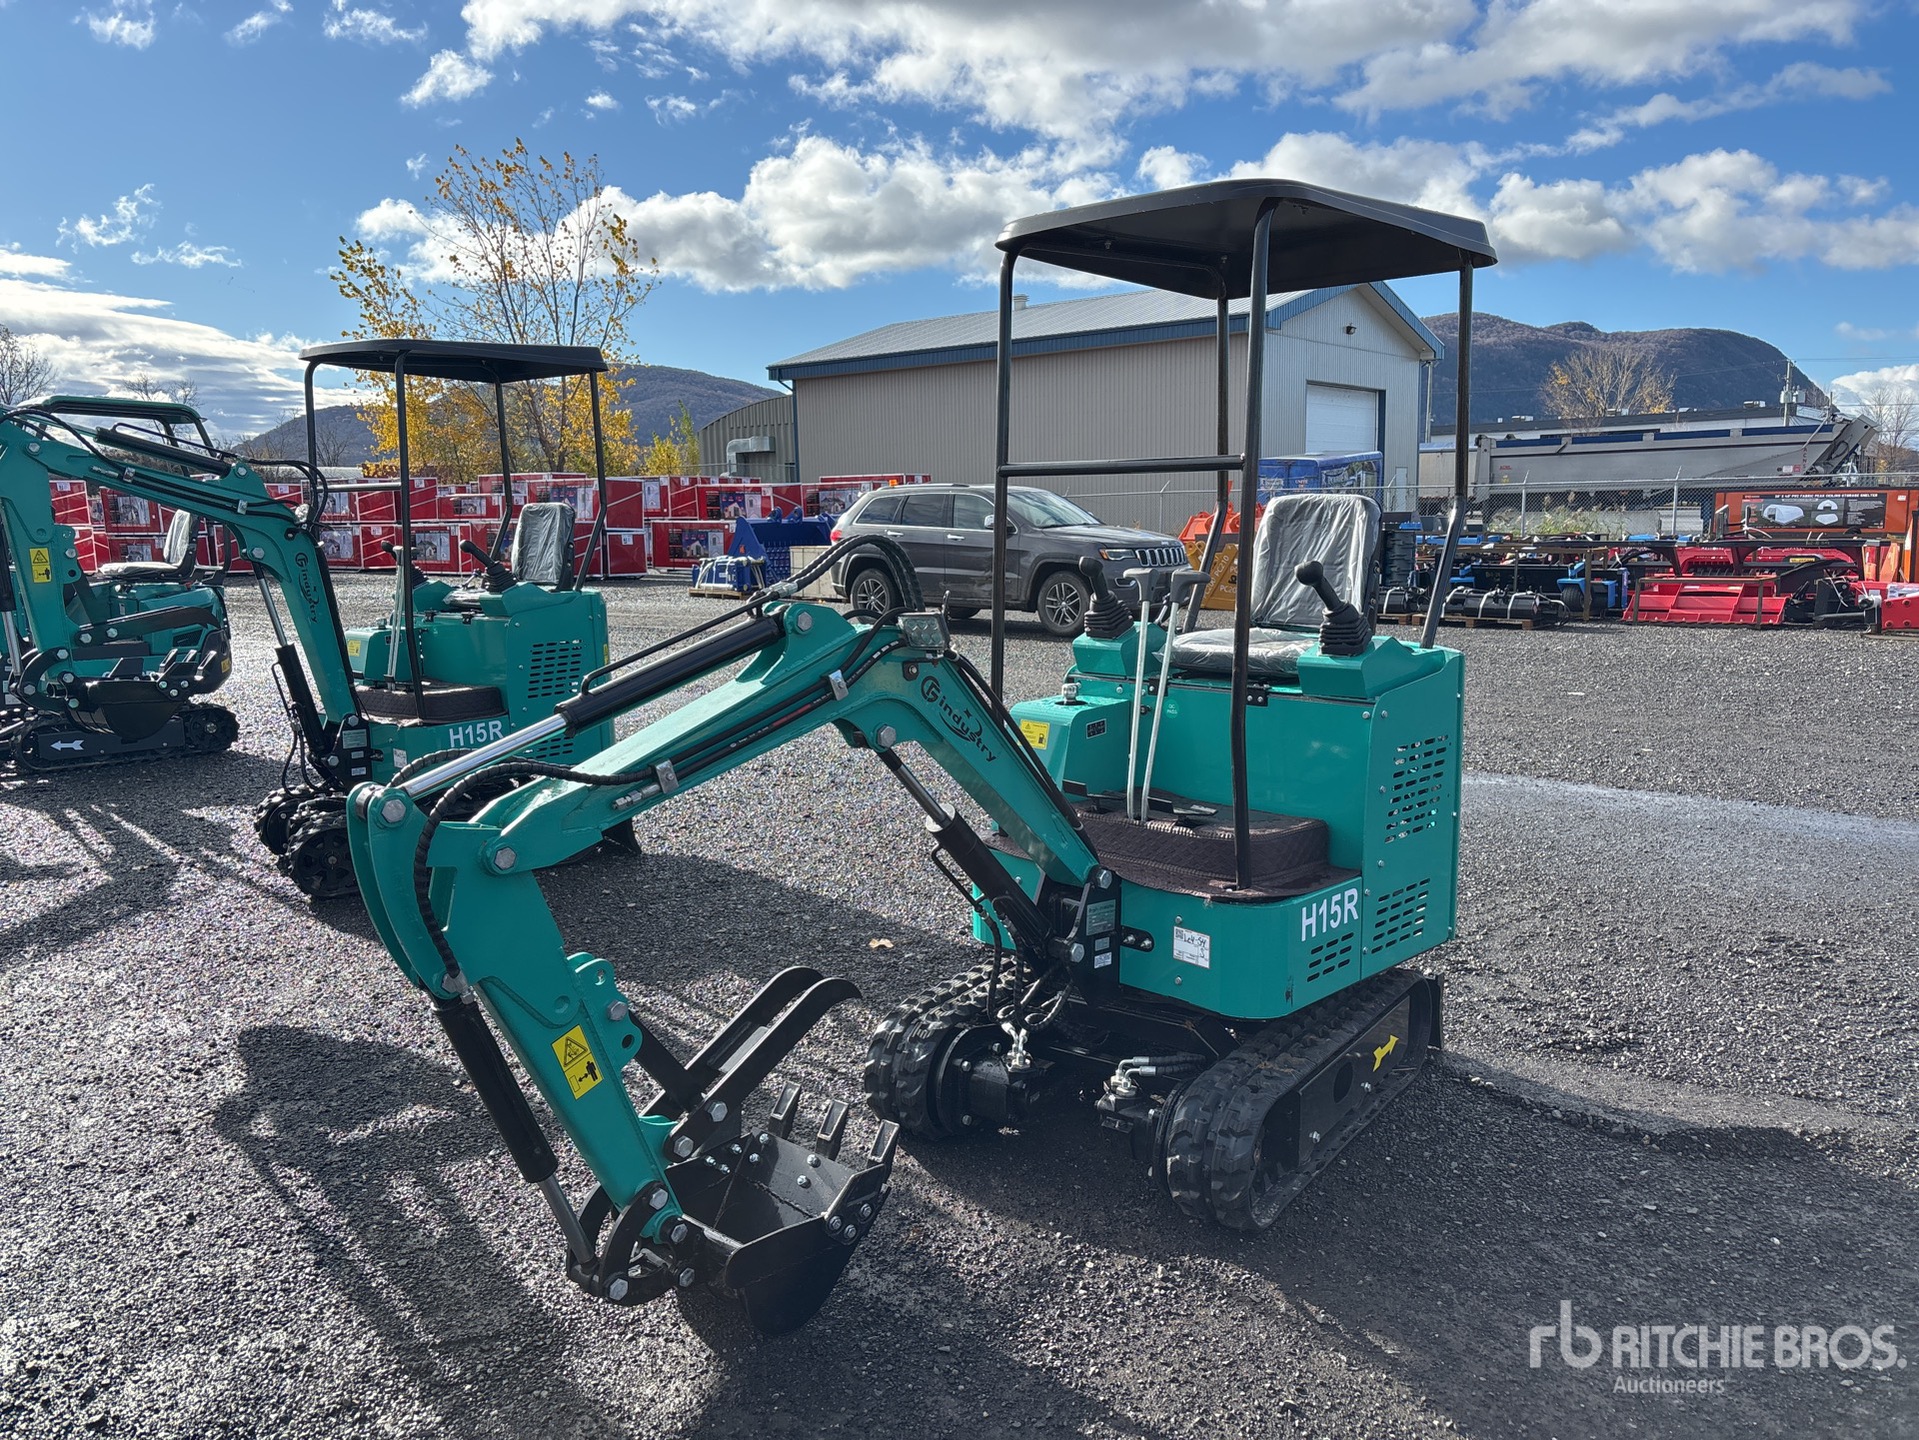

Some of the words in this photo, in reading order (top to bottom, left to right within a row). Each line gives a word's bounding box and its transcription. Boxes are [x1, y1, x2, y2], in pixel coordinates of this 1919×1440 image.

[1213, 555, 1230, 577] PC210
[449, 720, 504, 748] H15R
[921, 675, 996, 762] Gindustry
[1301, 888, 1359, 942] H15R
